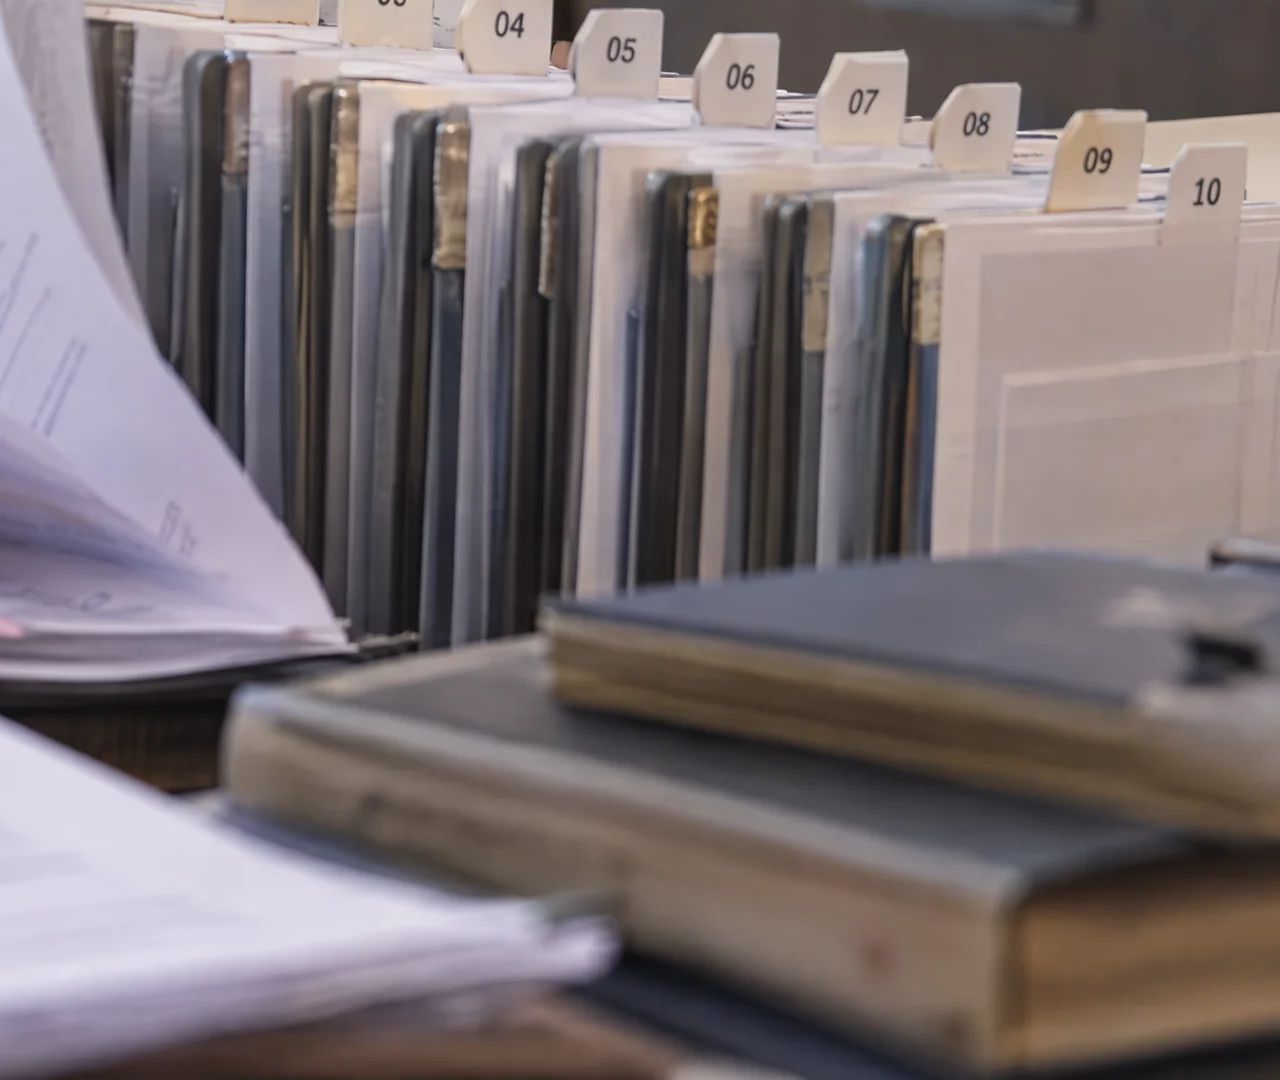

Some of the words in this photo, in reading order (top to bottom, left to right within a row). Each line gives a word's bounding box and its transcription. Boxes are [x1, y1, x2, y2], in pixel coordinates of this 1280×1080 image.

[494, 10, 525, 39] 04
[606, 35, 637, 64] 05
[726, 63, 755, 90] 06
[848, 88, 880, 115] 07
[962, 111, 991, 137] 08
[1083, 146, 1113, 174] 09
[1192, 177, 1222, 207] 10
